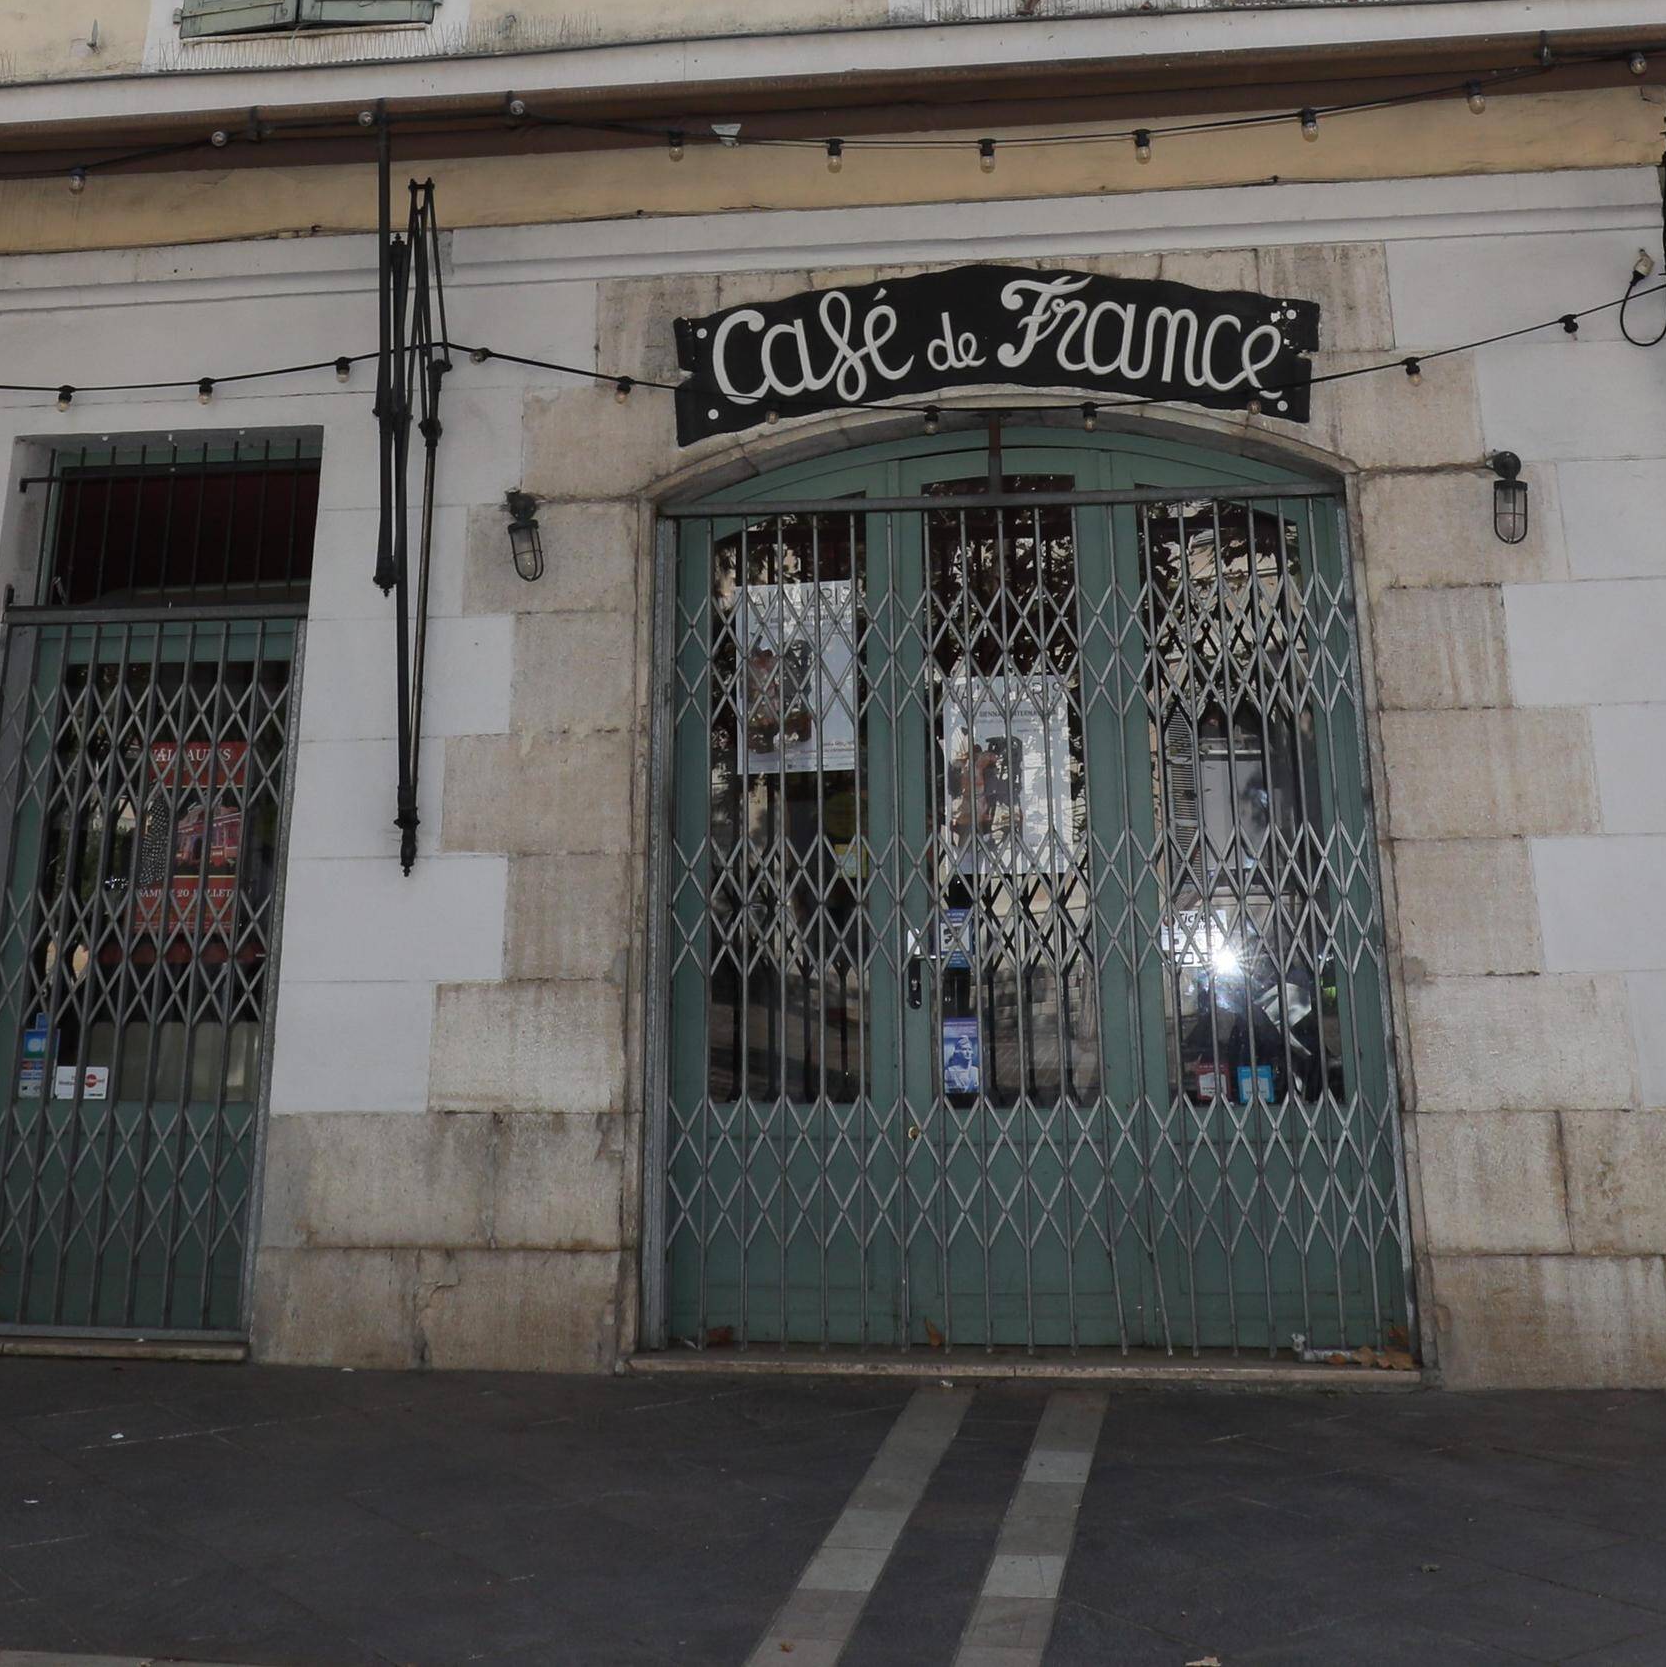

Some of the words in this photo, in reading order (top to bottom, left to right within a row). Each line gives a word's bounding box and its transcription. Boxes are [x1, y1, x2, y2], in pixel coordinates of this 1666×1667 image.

[712, 289, 915, 406] Café
[927, 313, 987, 372] de
[997, 274, 1283, 400] France
